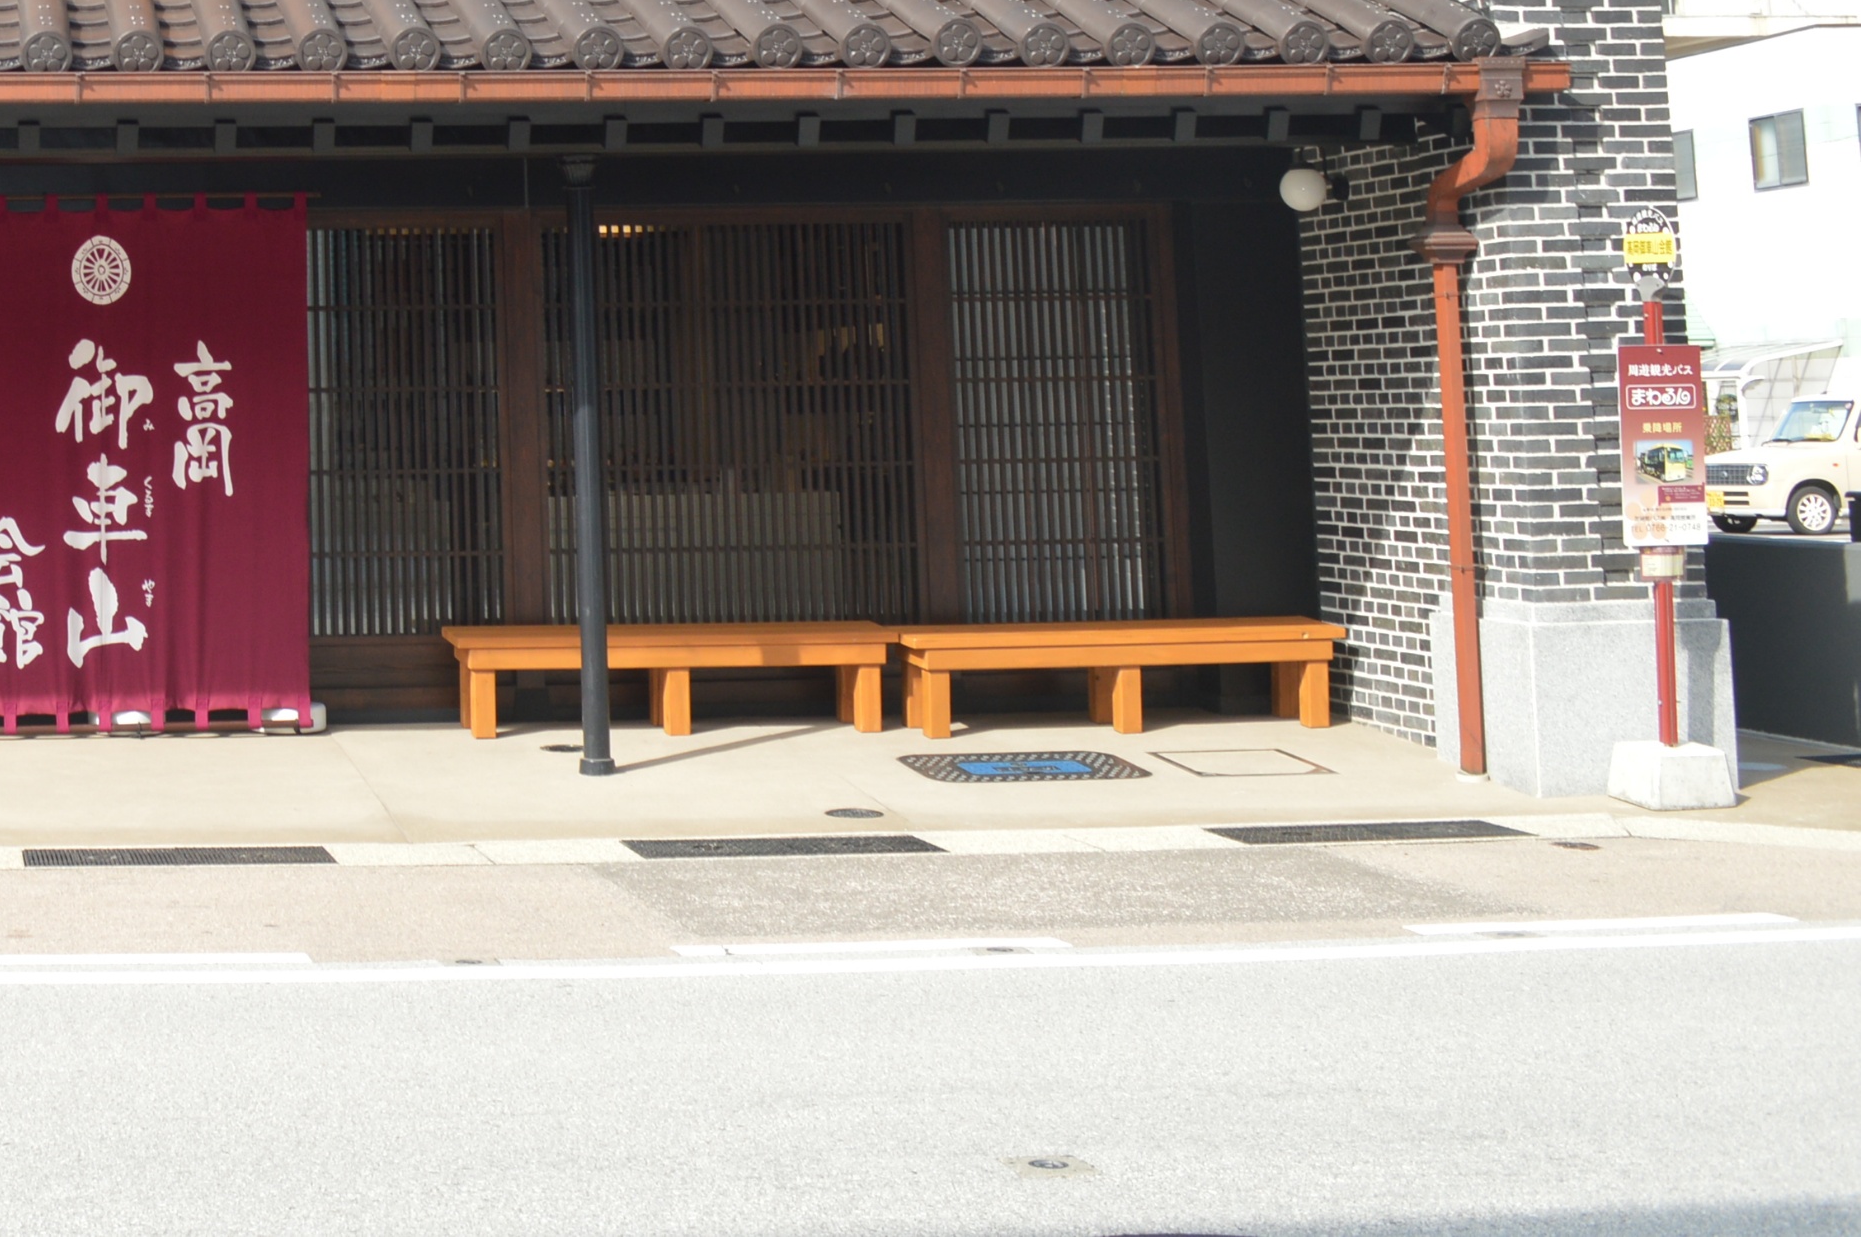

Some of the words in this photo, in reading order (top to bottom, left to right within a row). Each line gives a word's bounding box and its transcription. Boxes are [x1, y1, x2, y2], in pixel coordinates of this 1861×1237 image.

[1628, 364, 1693, 377] 周遊観光バス
[1631, 388, 1691, 406] まわるん
[172, 340, 234, 497] 高岡
[1642, 422, 1682, 433] 乗降場所
[54, 338, 154, 668] 御車山
